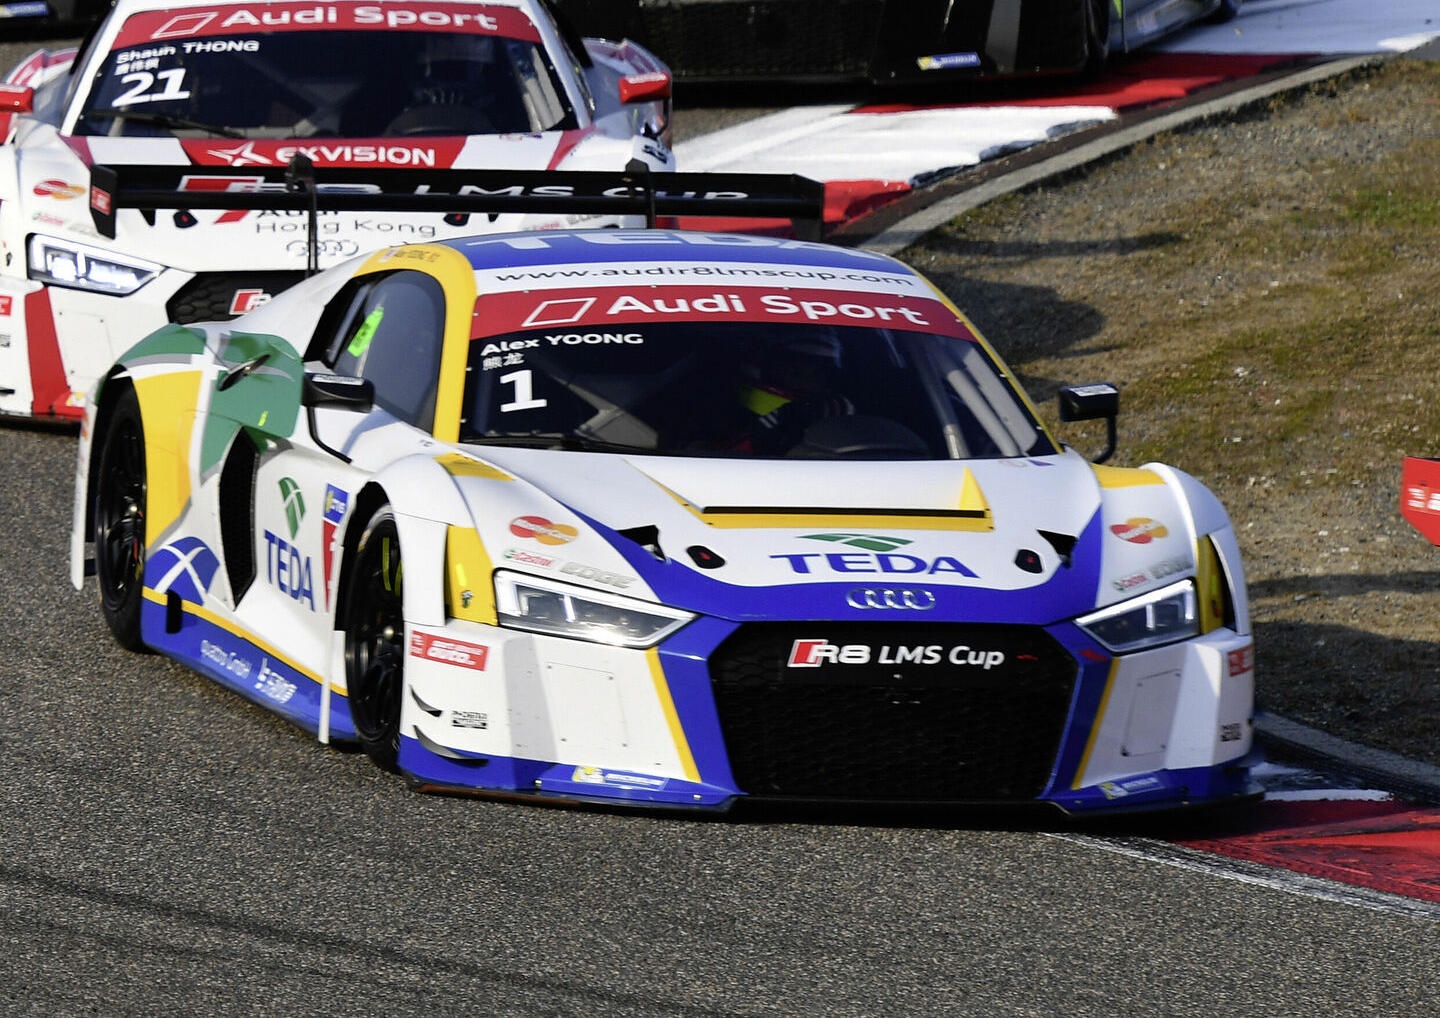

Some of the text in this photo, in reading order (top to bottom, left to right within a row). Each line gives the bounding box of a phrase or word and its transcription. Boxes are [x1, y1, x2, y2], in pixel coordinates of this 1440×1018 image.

[221, 6, 499, 32] Audi Sport
[116, 39, 260, 64] Shaun THONG
[111, 68, 191, 108] 21
[415, 184, 575, 198] LMS
[355, 219, 436, 238] Kong
[496, 266, 914, 287] www.audir8lmscup.com
[606, 293, 931, 326] Audi Sport
[480, 333, 645, 357] Alex YOONG
[499, 369, 548, 413] 1
[263, 529, 316, 613] TEDA
[769, 552, 981, 579] TEDA
[803, 643, 1006, 670] R8 LMS Cup
